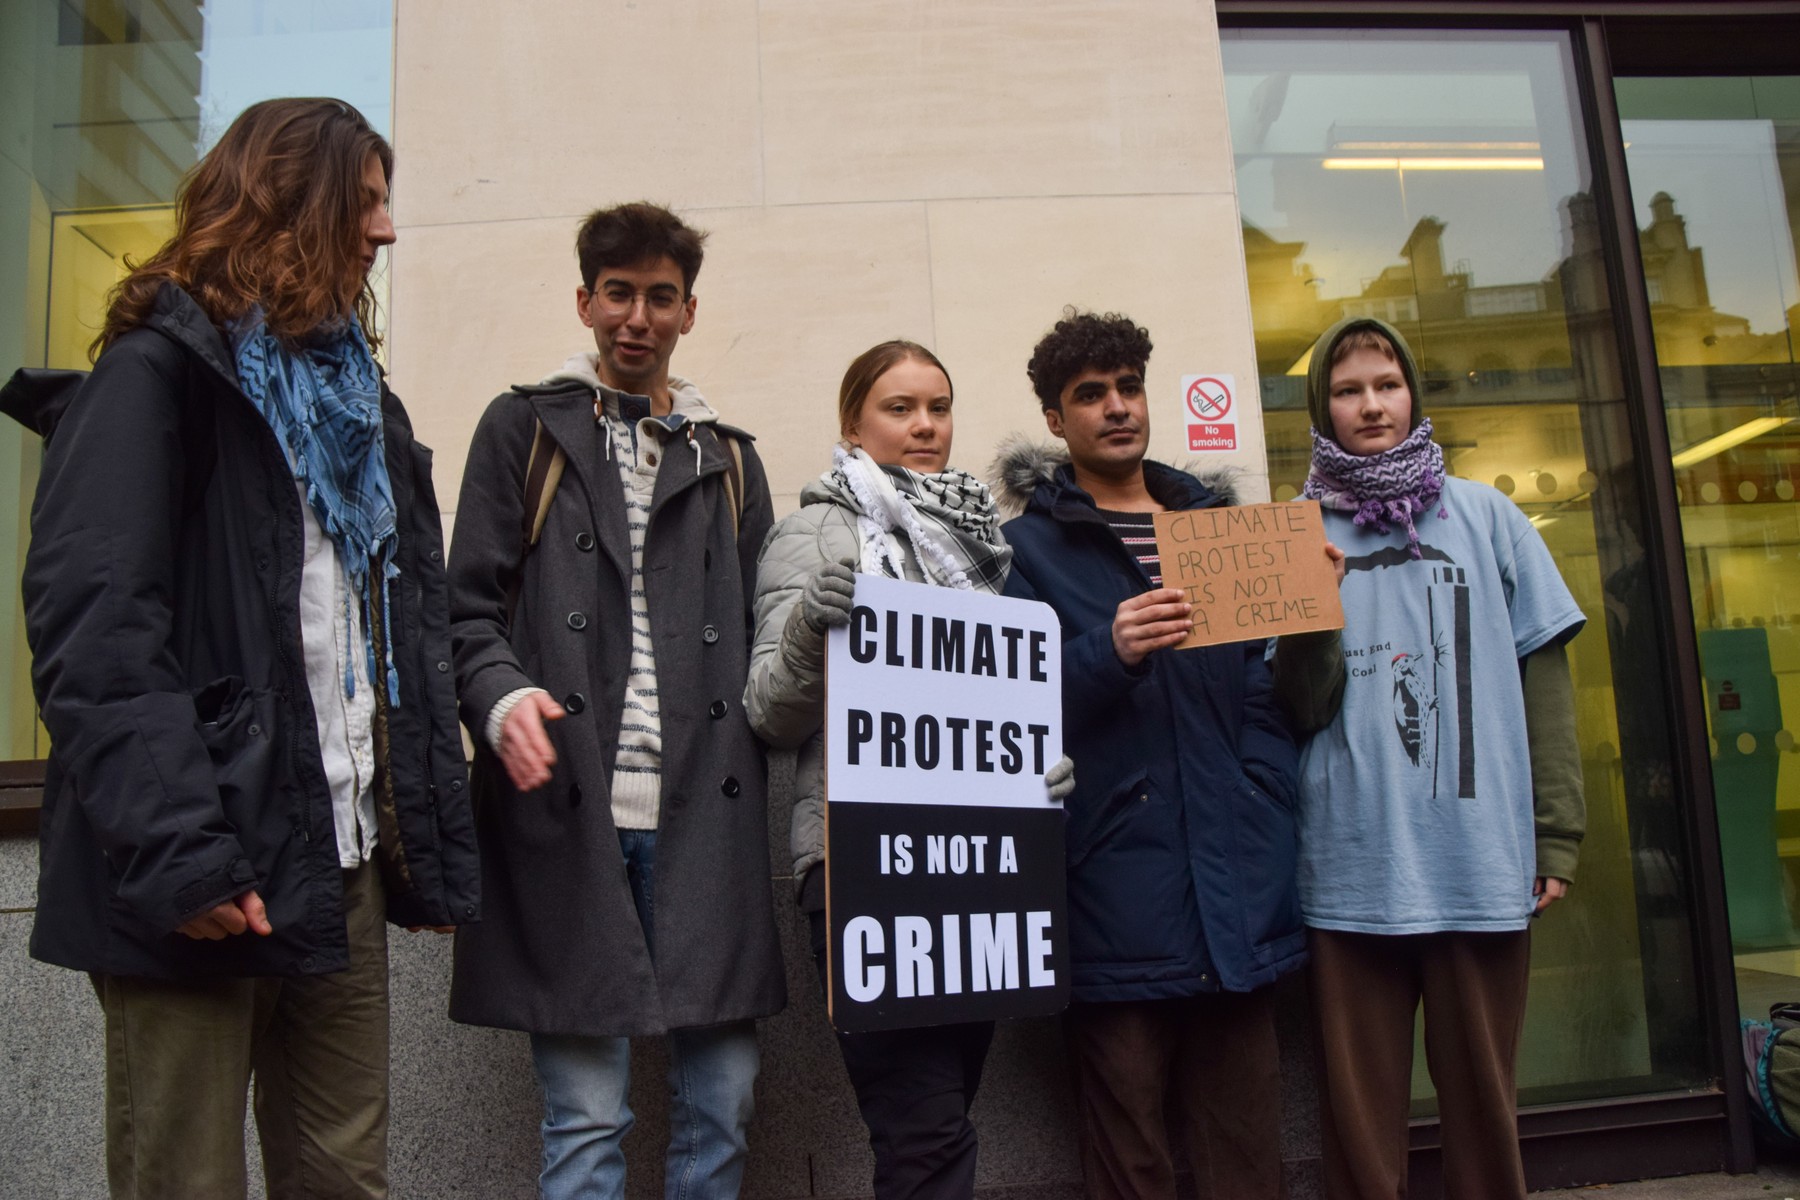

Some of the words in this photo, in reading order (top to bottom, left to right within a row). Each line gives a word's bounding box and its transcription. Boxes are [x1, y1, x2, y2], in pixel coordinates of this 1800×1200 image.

[1192, 438, 1234, 448] smoking
[1205, 426, 1219, 434] No
[1170, 505, 1306, 543] CLIMATE
[1177, 539, 1293, 580] PROTEST
[1183, 582, 1216, 605] IS
[1233, 573, 1285, 601] NOT
[1191, 608, 1211, 637] A
[1235, 598, 1320, 628] CRIME
[848, 604, 1048, 683] CLIMATE
[1344, 649, 1365, 657] ust
[1369, 642, 1391, 654] End
[1352, 664, 1376, 677] Coal
[847, 708, 1050, 776] PROTEST
[879, 834, 914, 875] IS
[926, 834, 988, 875] NOT
[998, 835, 1018, 874] A
[842, 910, 1056, 1003] CRIME
